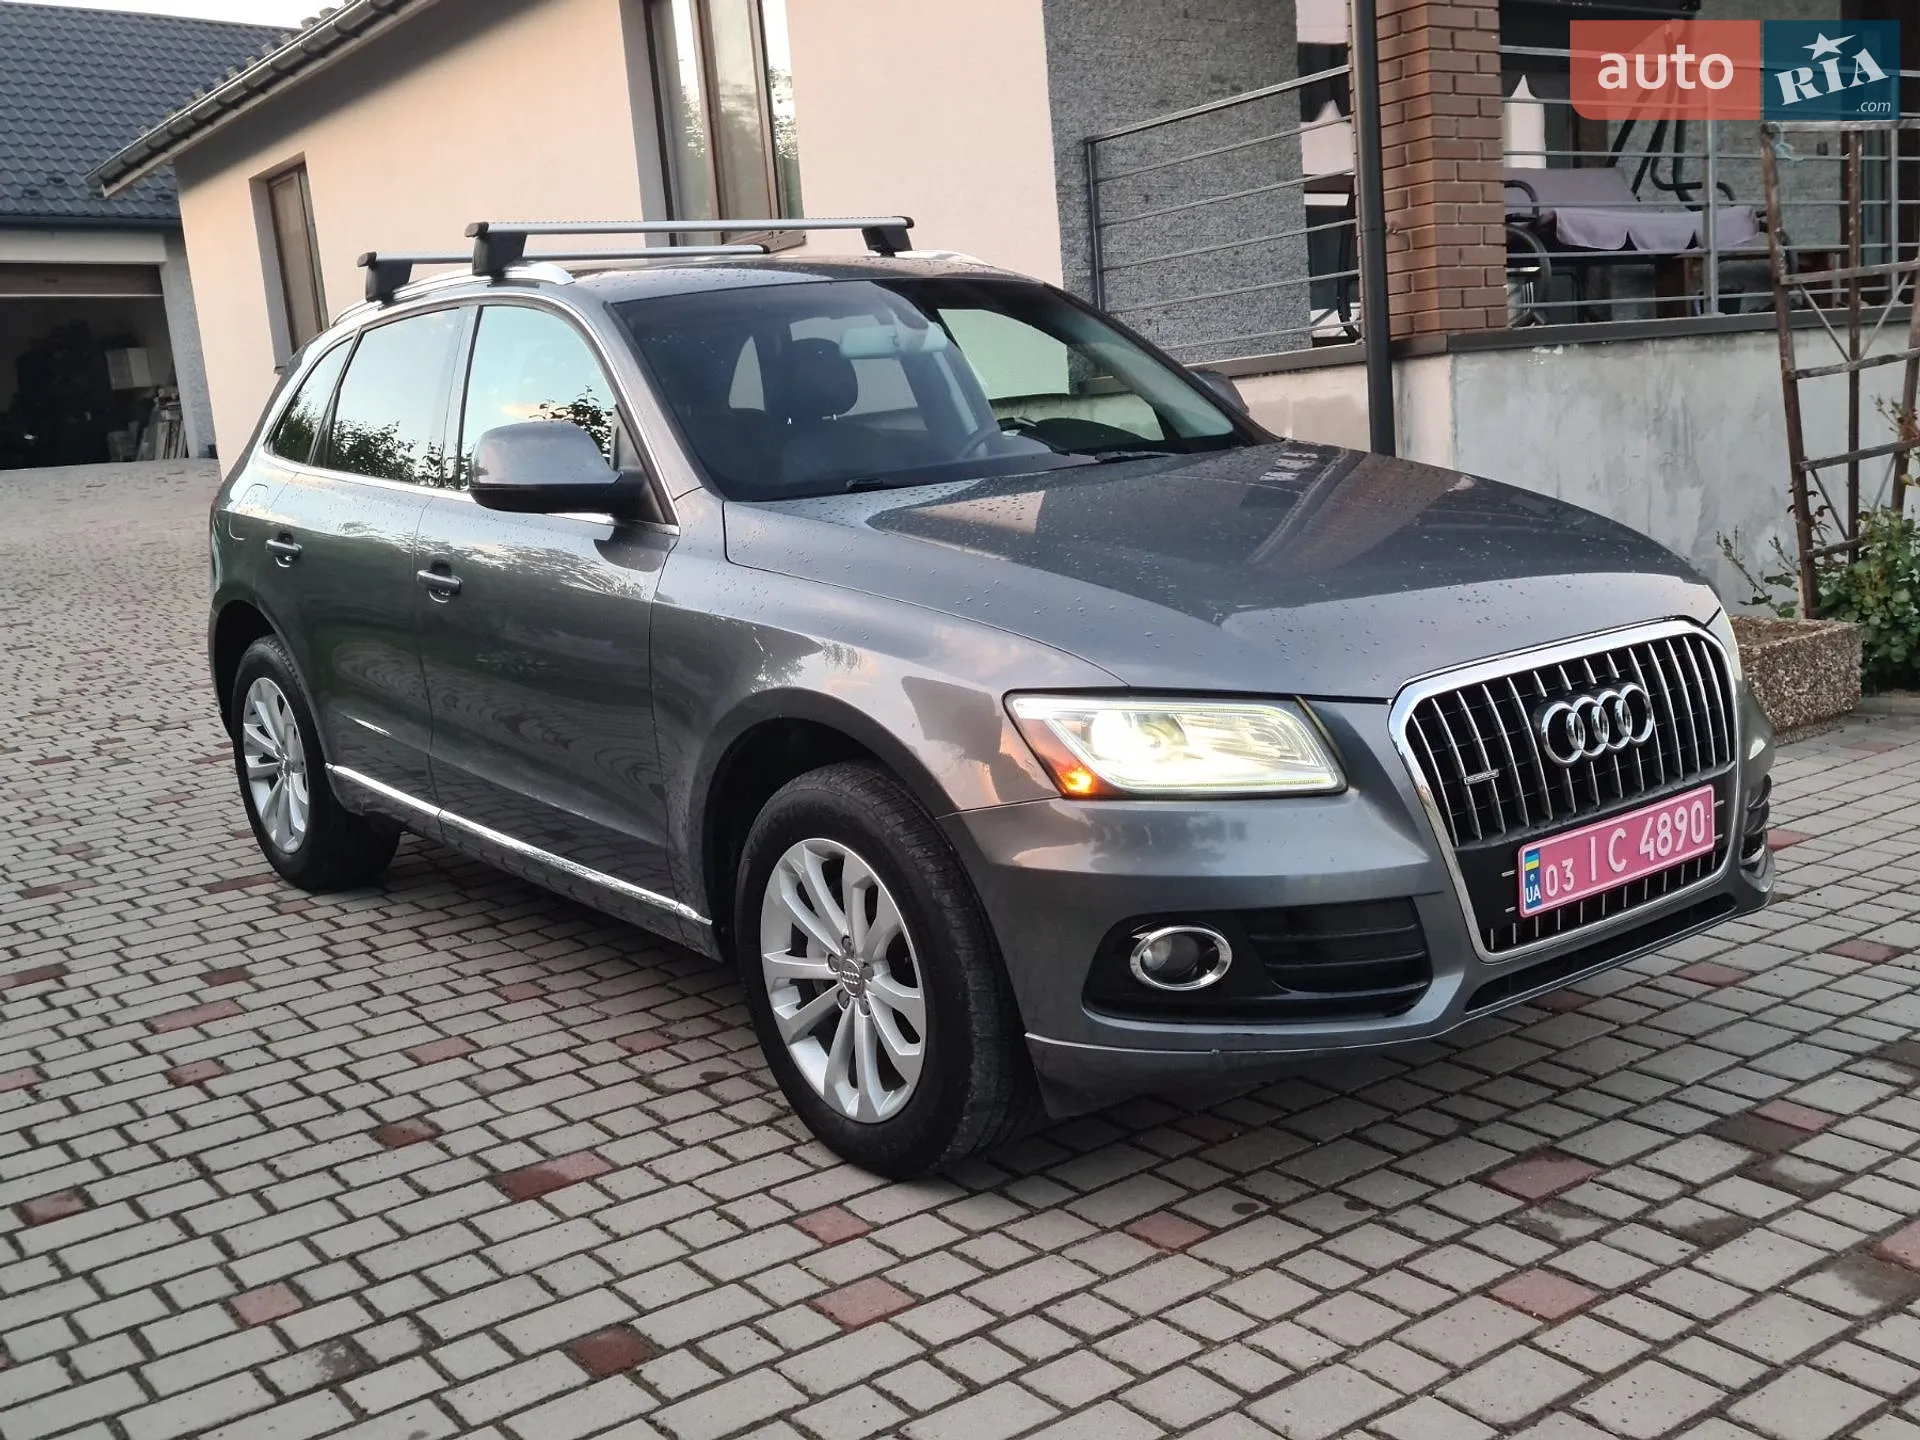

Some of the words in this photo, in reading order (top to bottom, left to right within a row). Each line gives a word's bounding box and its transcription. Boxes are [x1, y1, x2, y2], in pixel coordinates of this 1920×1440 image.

[1545, 858, 1575, 897] 03
[1589, 828, 1627, 882] IC
[1639, 800, 1706, 861] 4890
[1525, 884, 1541, 904] UA
